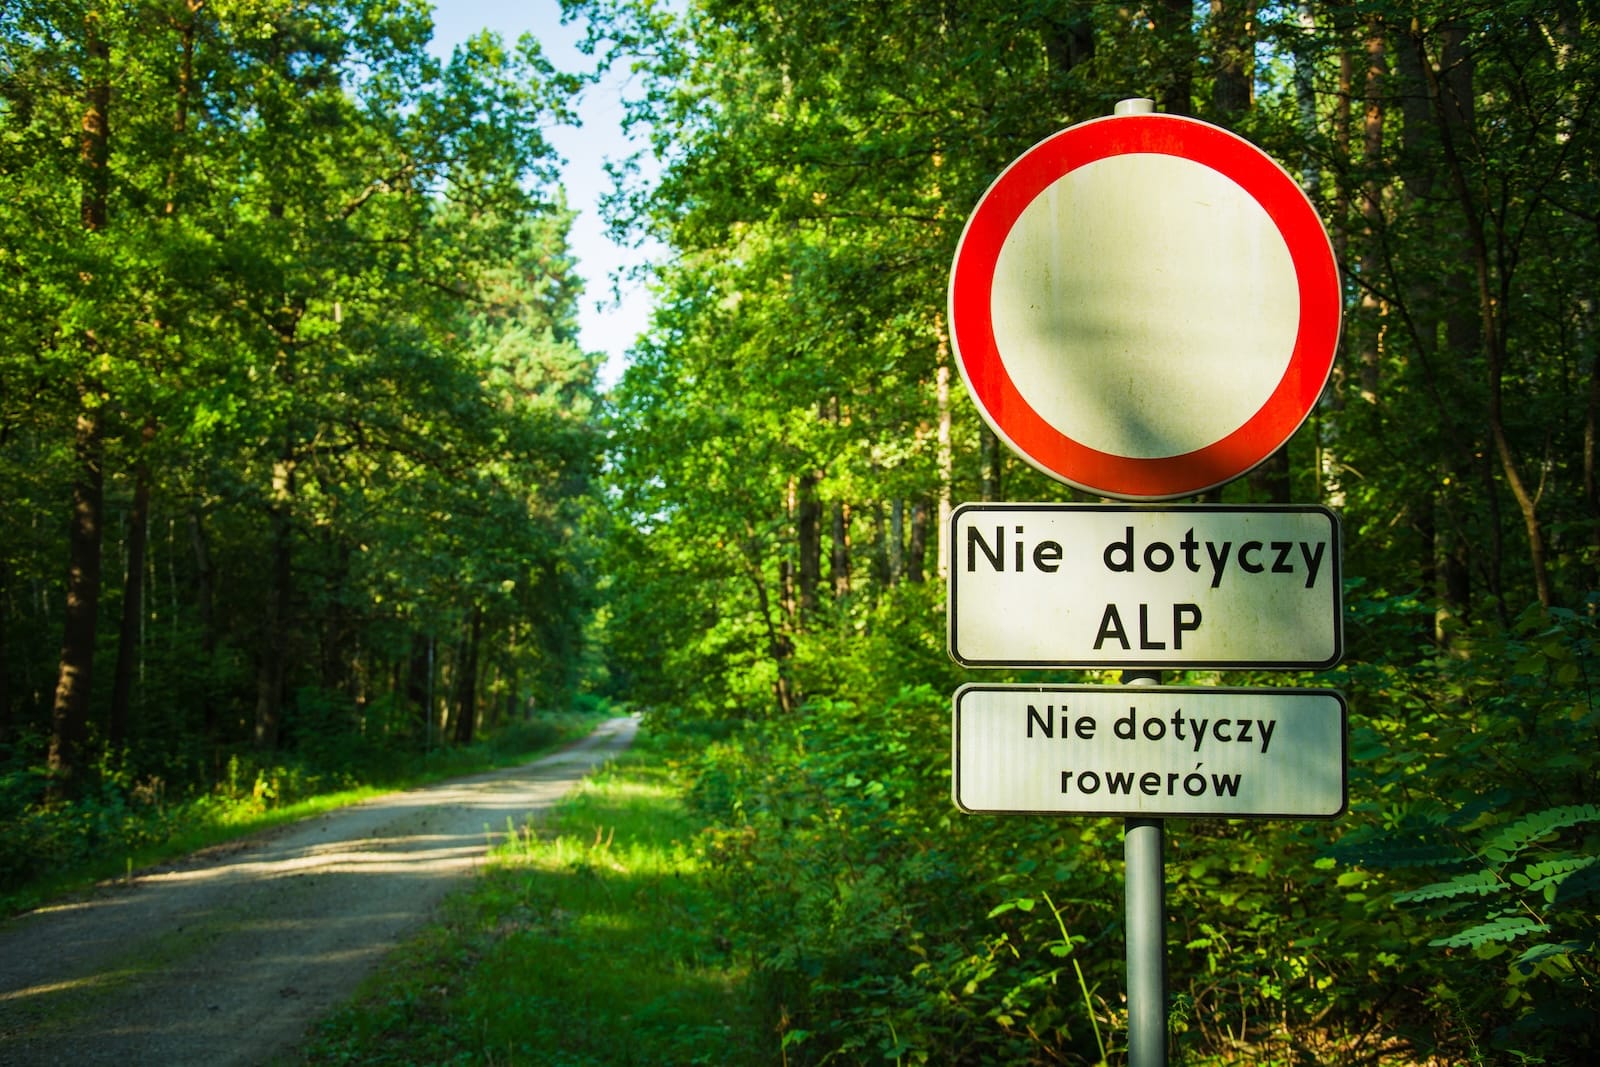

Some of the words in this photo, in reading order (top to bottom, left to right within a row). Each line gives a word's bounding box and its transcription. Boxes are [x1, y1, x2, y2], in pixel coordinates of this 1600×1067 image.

[967, 526, 1063, 573] Nie
[1103, 526, 1327, 590] dotyczy
[1092, 603, 1203, 650] ALP
[1027, 704, 1096, 740] Nie
[1113, 706, 1277, 754] dotyczy
[1061, 762, 1242, 798] rowerów
